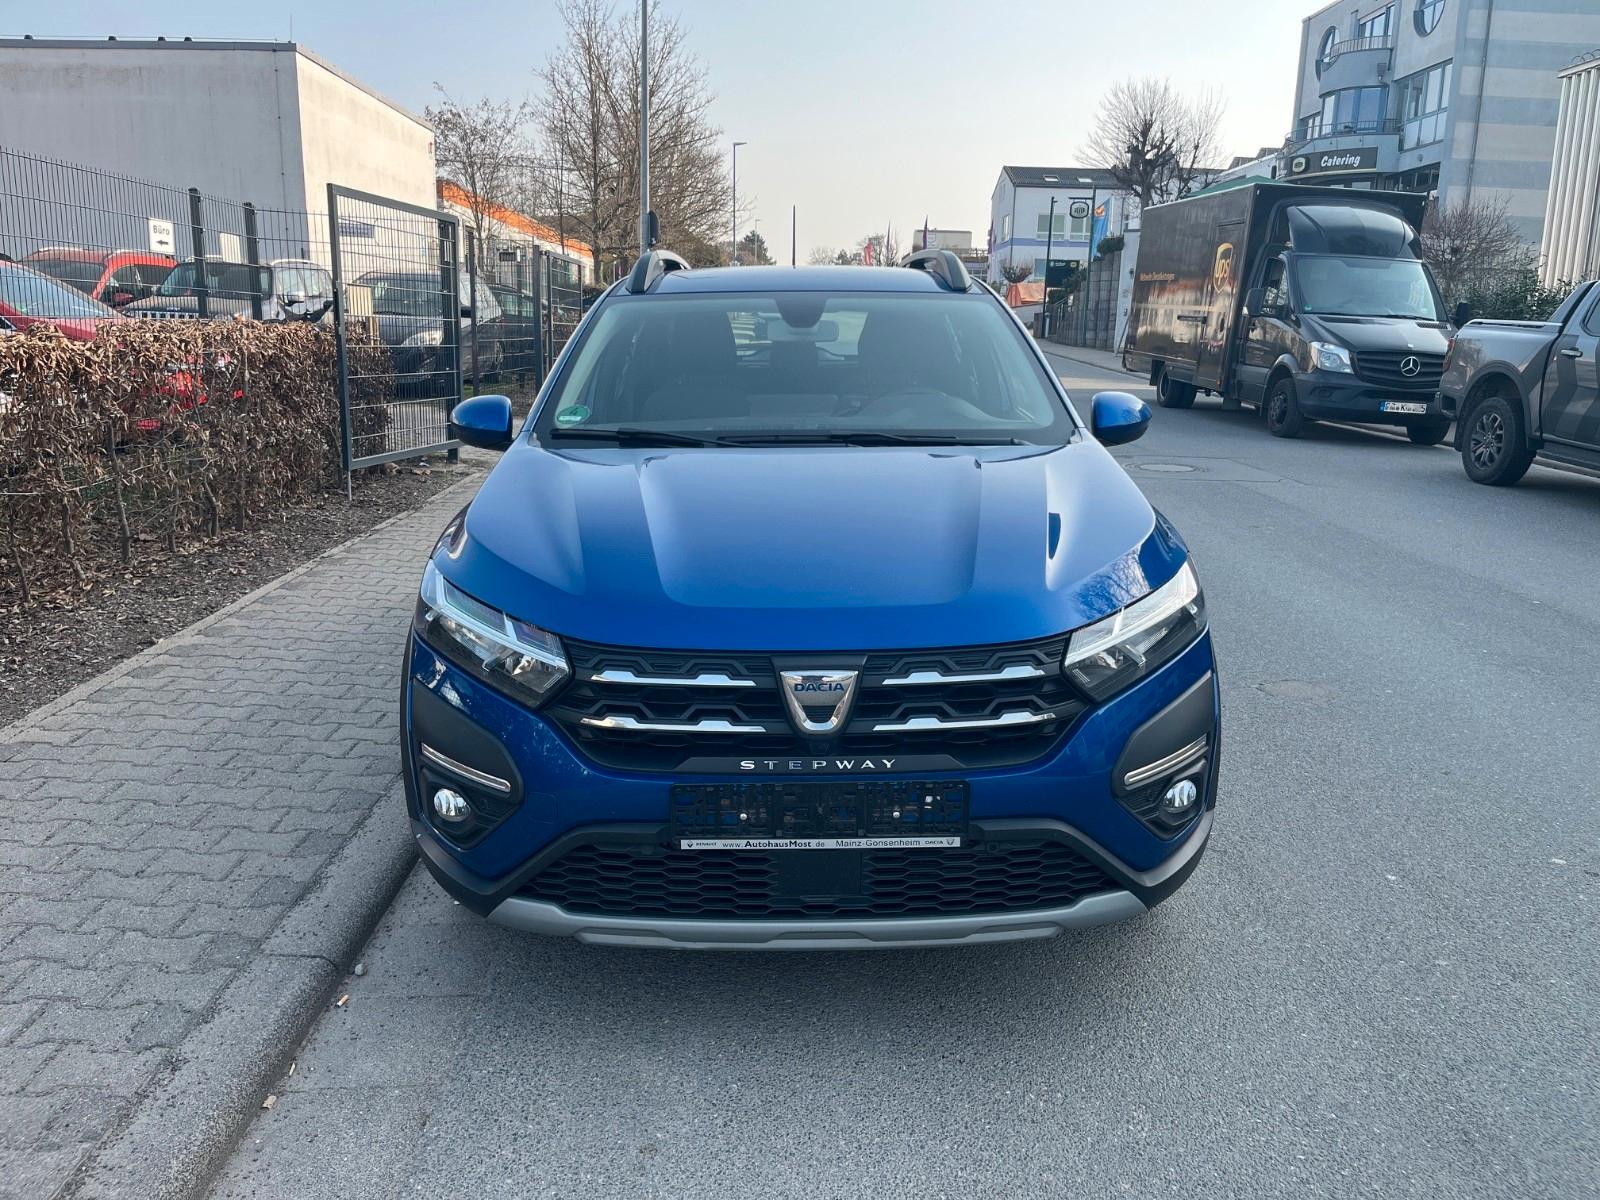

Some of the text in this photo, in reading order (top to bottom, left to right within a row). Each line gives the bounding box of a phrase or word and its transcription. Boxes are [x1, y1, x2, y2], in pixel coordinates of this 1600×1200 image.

[1321, 154, 1361, 168] Catering
[153, 225, 170, 236] Büro
[1215, 259, 1230, 286] ups
[794, 683, 845, 692] DACIA
[740, 759, 896, 770] STEPWAY
[835, 839, 921, 848] Mainz-Gonsenheim
